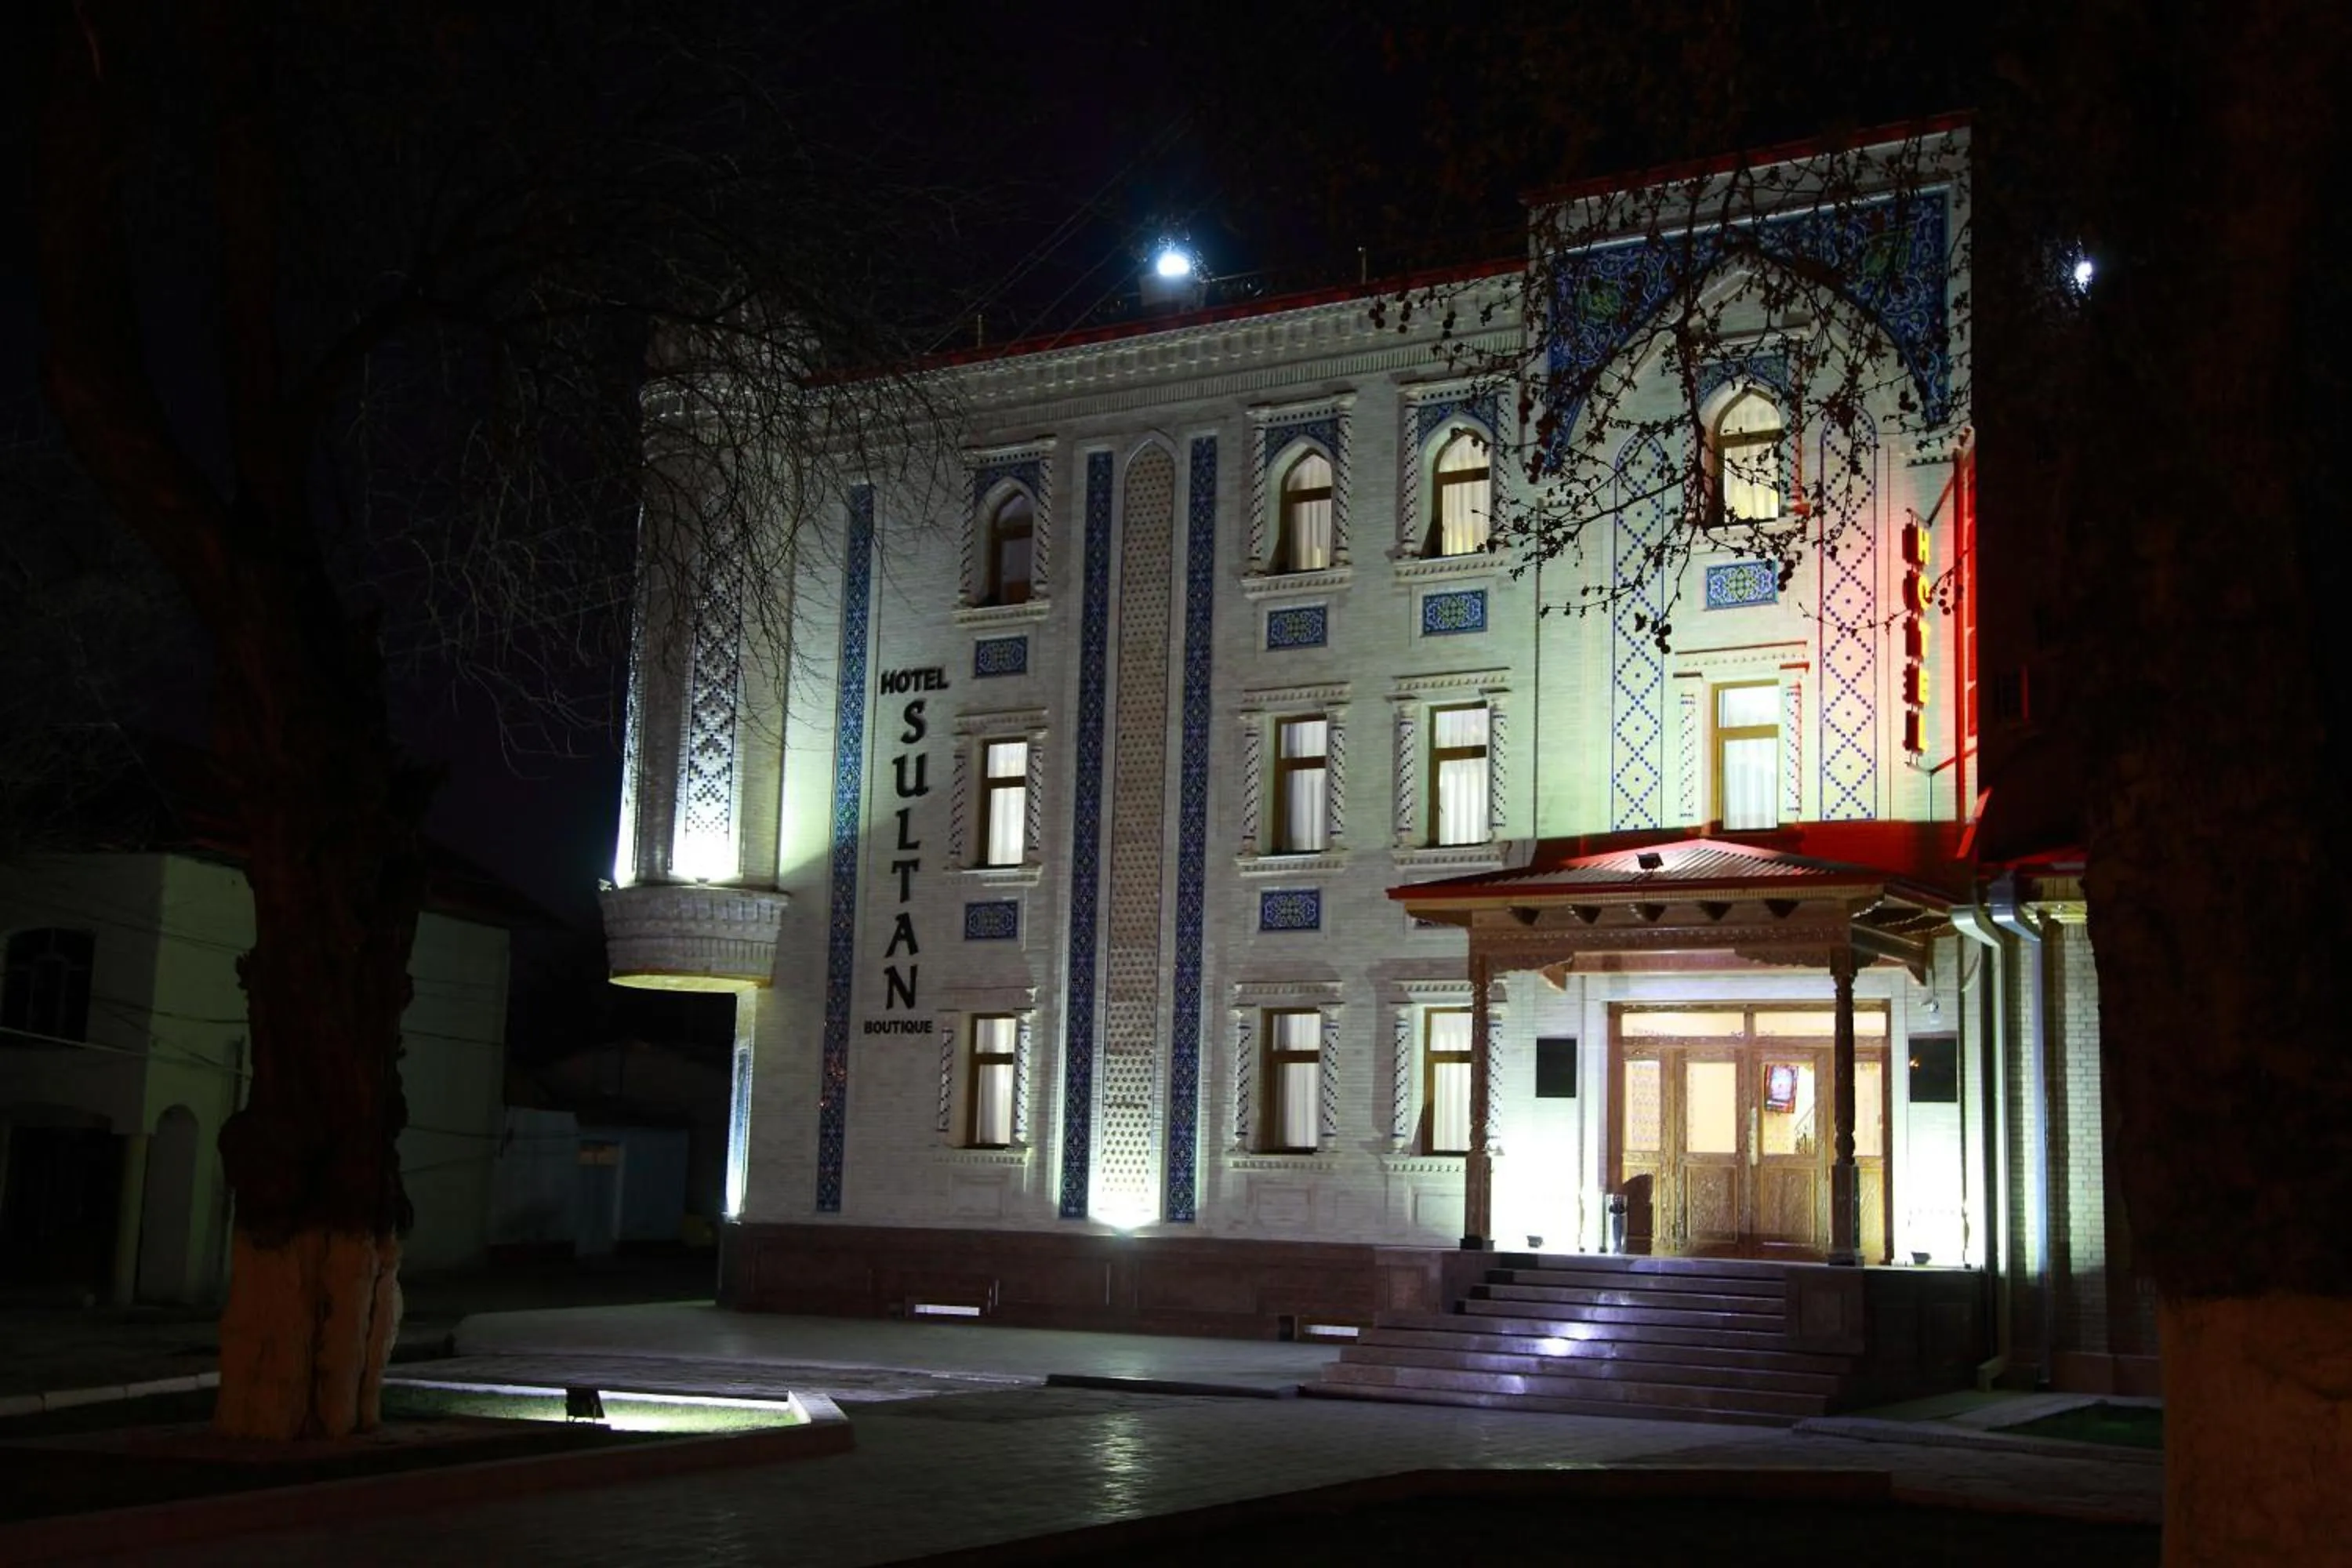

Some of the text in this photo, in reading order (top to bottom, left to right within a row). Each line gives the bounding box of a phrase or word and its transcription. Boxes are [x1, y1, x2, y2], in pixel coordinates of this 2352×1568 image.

[880, 666, 950, 695] HOTEL
[884, 698, 930, 1011] SULTAN
[864, 1020, 933, 1035] BOUTIQUE
